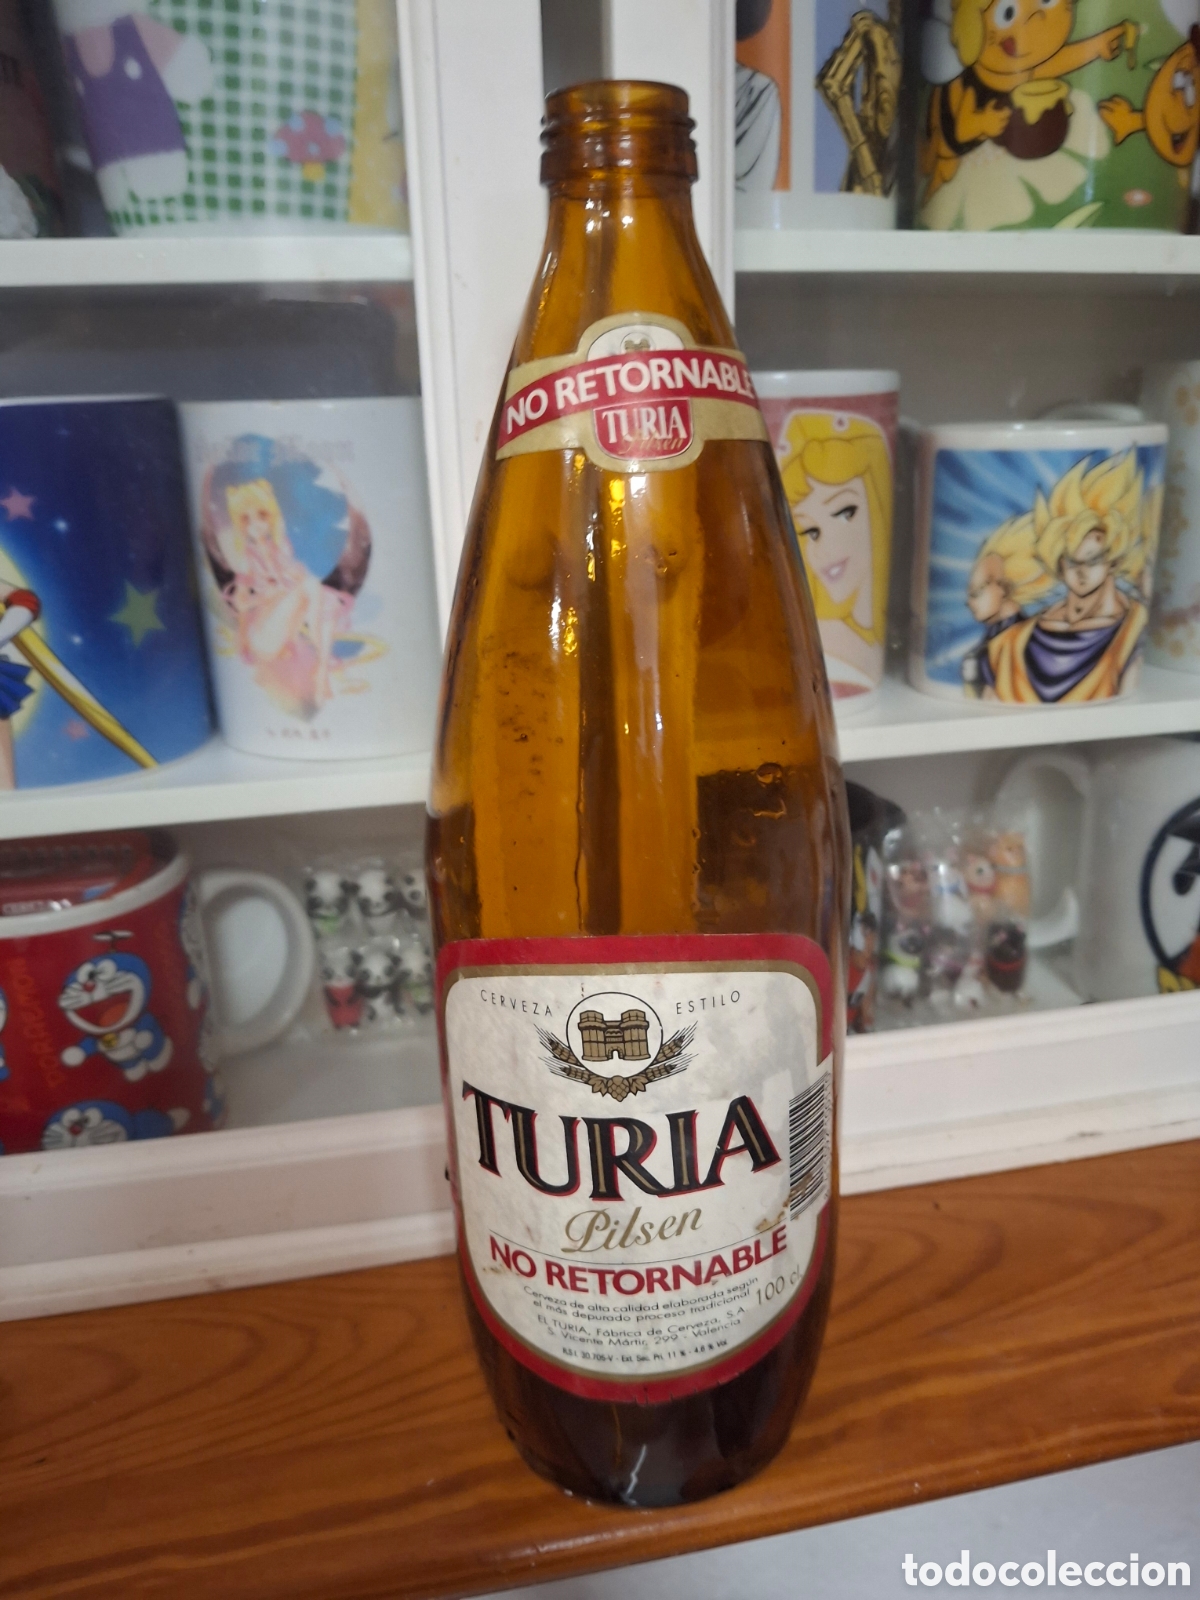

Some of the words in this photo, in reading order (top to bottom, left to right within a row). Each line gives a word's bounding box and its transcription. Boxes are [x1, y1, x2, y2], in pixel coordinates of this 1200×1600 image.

[506, 387, 548, 435] NO
[602, 405, 688, 444] TURIA
[480, 989, 553, 1017] CERVEZA
[676, 990, 741, 1015] ESTILO
[462, 1080, 782, 1202] TURIA
[561, 1206, 703, 1253] Pilsen
[489, 1234, 537, 1278] NO
[545, 1224, 787, 1296] RETORNABLE
[523, 1285, 567, 1306] Cerveza
[569, 1300, 585, 1309] de
[588, 1303, 610, 1312] alta
[613, 1302, 660, 1313] calidad
[662, 1290, 724, 1310] elaborada
[726, 1276, 759, 1295] según
[756, 1275, 785, 1305] 100
[790, 1264, 800, 1285] cl
[533, 1299, 542, 1308] el
[545, 1303, 568, 1315] más
[572, 1310, 632, 1322] depurado
[636, 1309, 686, 1323] proceso
[690, 1287, 750, 1313] tradicional
[537, 1314, 549, 1326] EL
[597, 1327, 642, 1338] Fábrica
[646, 1327, 663, 1337] de
[560, 1330, 604, 1347] Vicente
[654, 1333, 678, 1346] 299
[691, 1318, 742, 1339] Valencia
